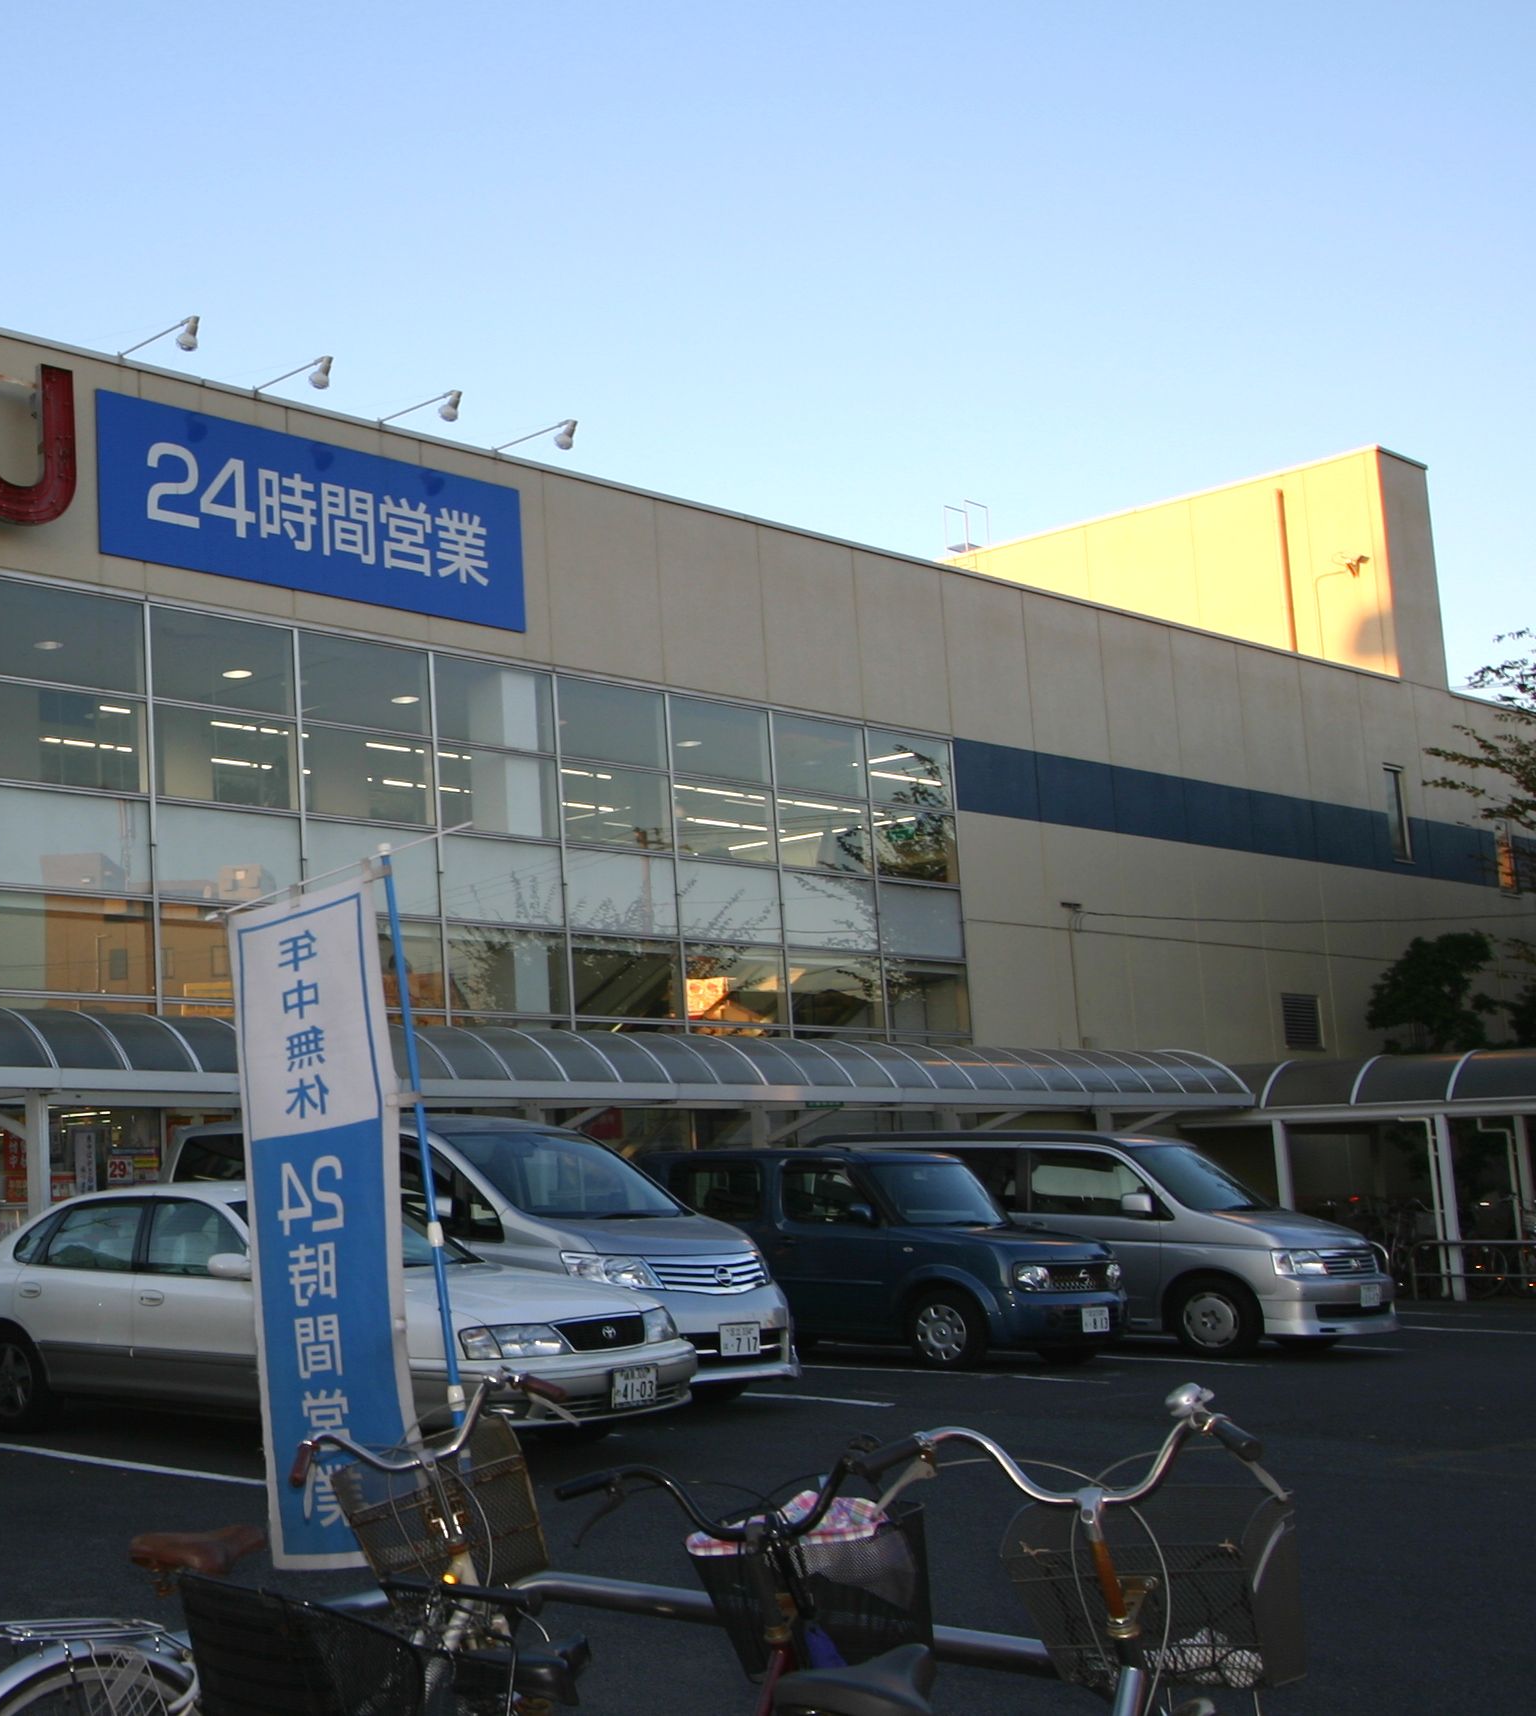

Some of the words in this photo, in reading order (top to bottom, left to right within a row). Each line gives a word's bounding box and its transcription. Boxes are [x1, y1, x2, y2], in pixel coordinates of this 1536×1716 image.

[146, 441, 492, 590] 24時間営業
[622, 1380, 654, 1401] 41-03
